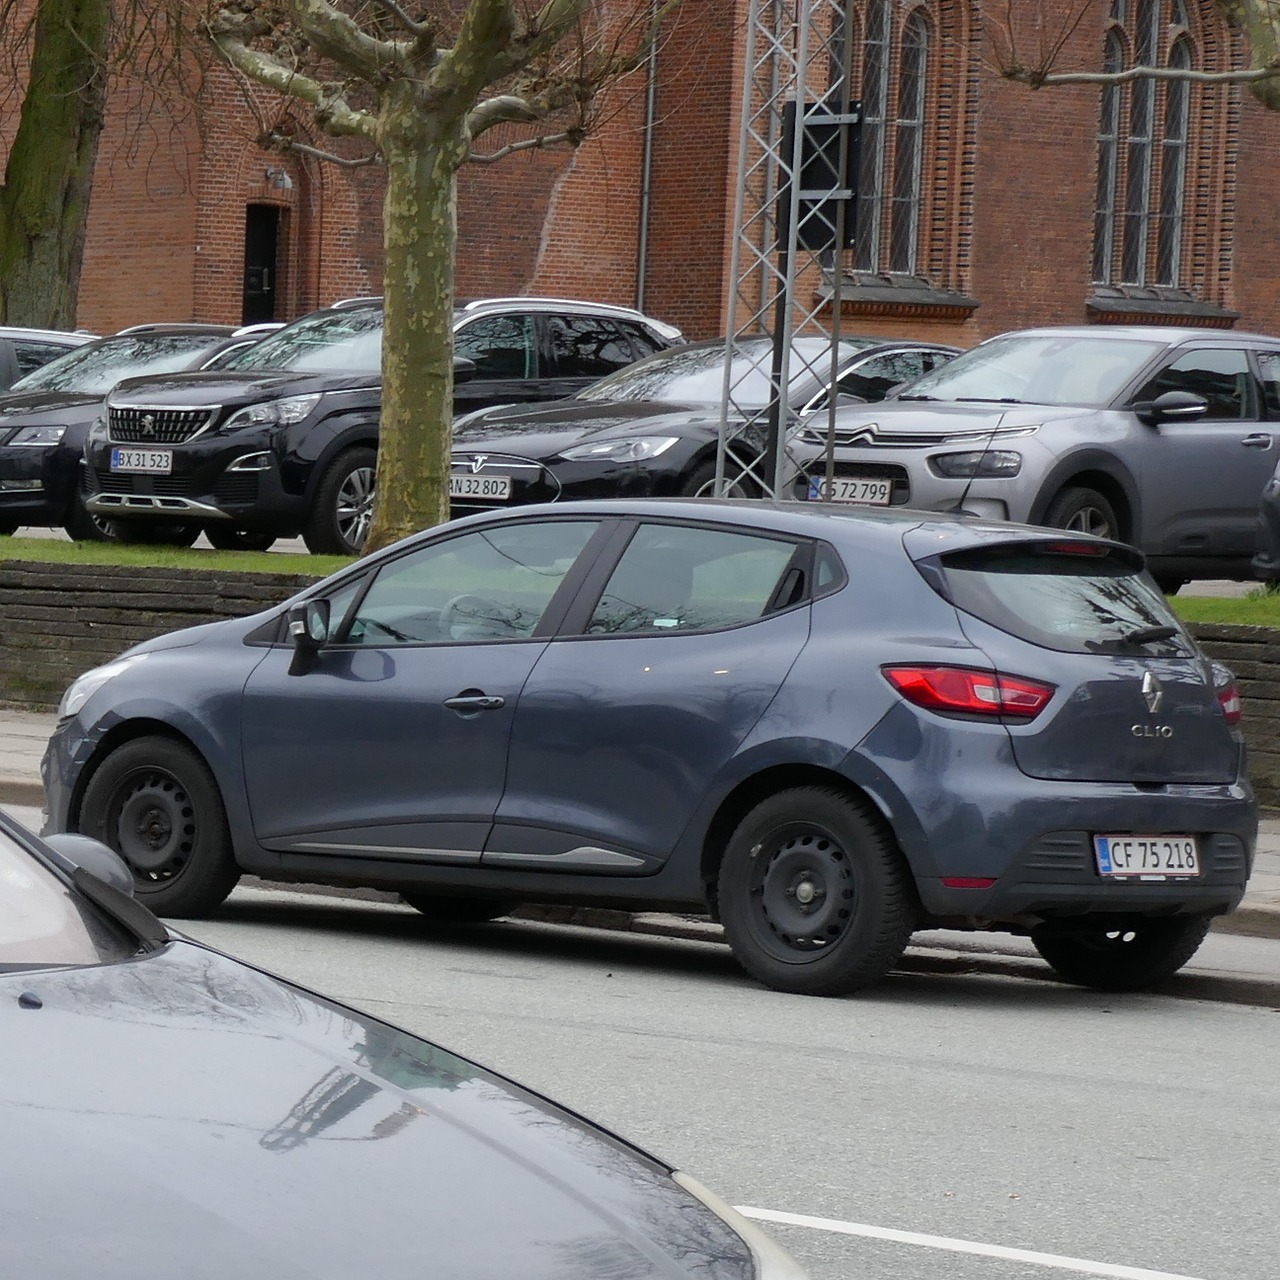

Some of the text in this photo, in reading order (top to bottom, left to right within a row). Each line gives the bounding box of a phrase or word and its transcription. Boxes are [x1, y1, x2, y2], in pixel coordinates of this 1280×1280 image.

[118, 452, 170, 468] BX 31 523
[465, 479, 480, 494] 32
[482, 479, 508, 496] 802
[840, 482, 857, 499] 72
[860, 483, 887, 500] 799
[1111, 841, 1196, 869] CF 75 218
